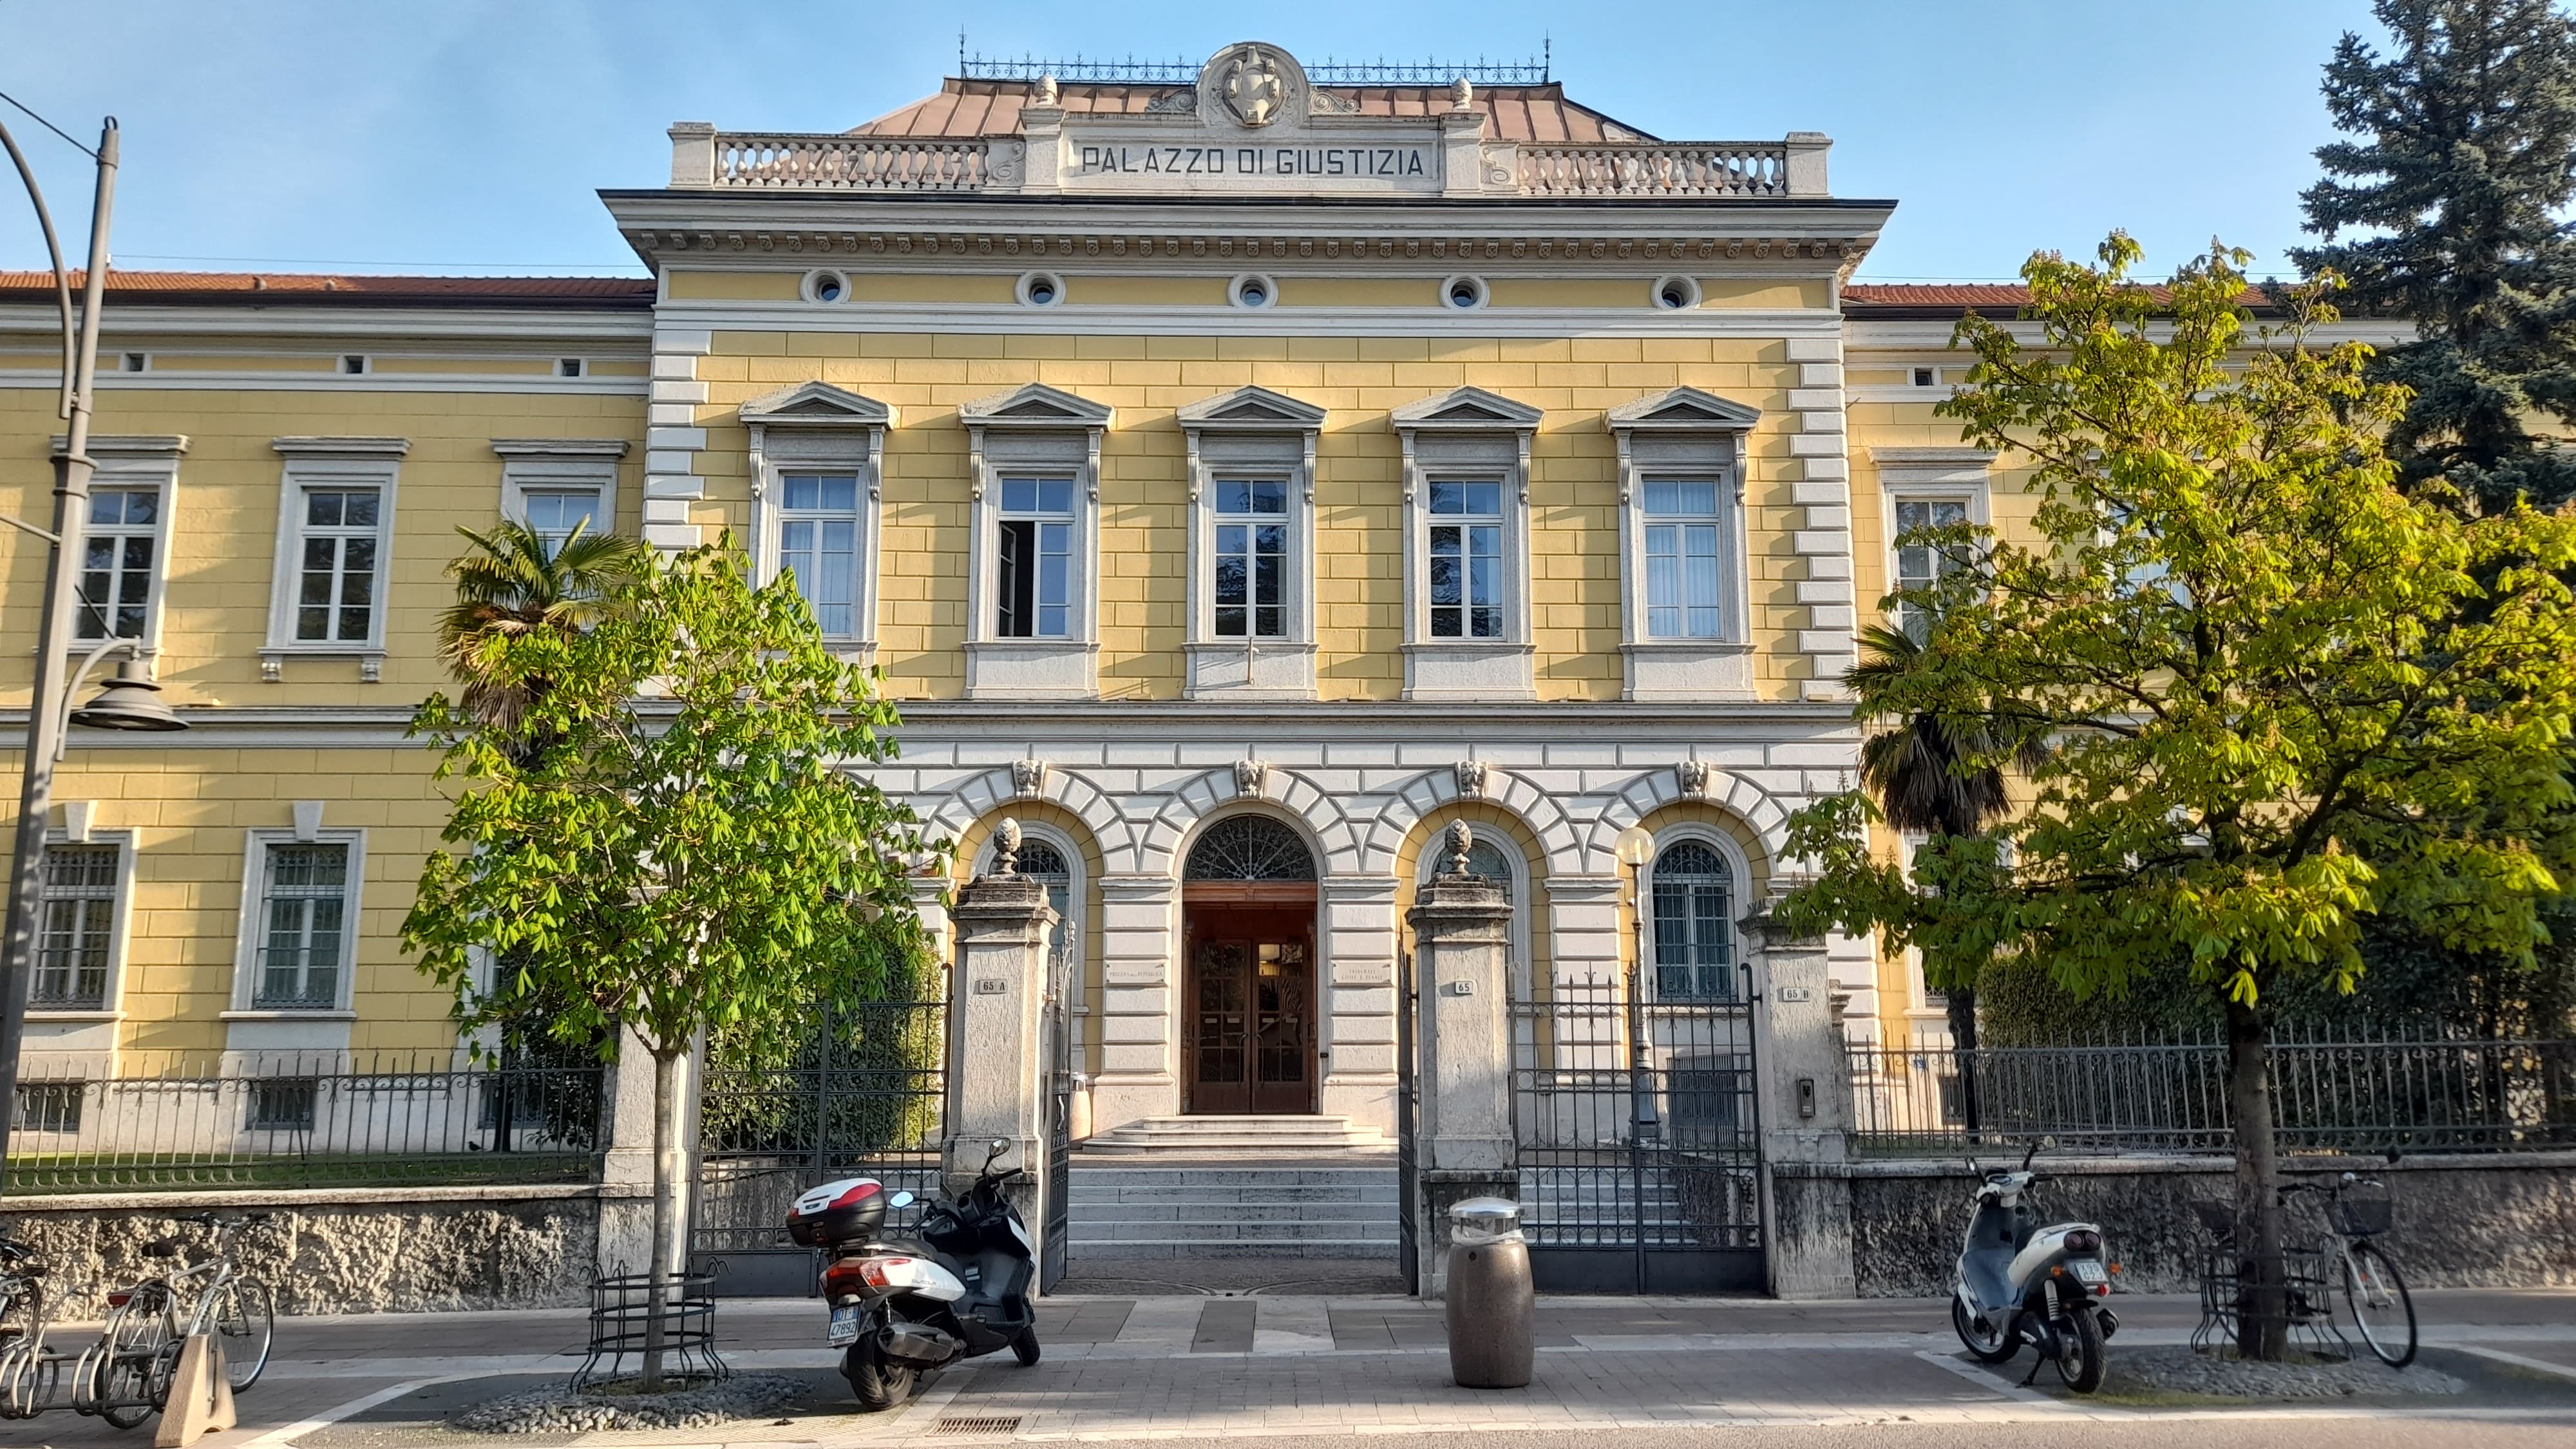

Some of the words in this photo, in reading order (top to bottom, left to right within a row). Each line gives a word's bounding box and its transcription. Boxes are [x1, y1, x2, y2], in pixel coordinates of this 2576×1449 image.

[1082, 147, 1224, 173] PALAZZO
[1238, 148, 1263, 174] DI
[1276, 149, 1423, 175] GIUSTIZIA
[983, 981, 994, 990] 65
[999, 982, 1005, 990] A
[1787, 989, 1797, 998] 65
